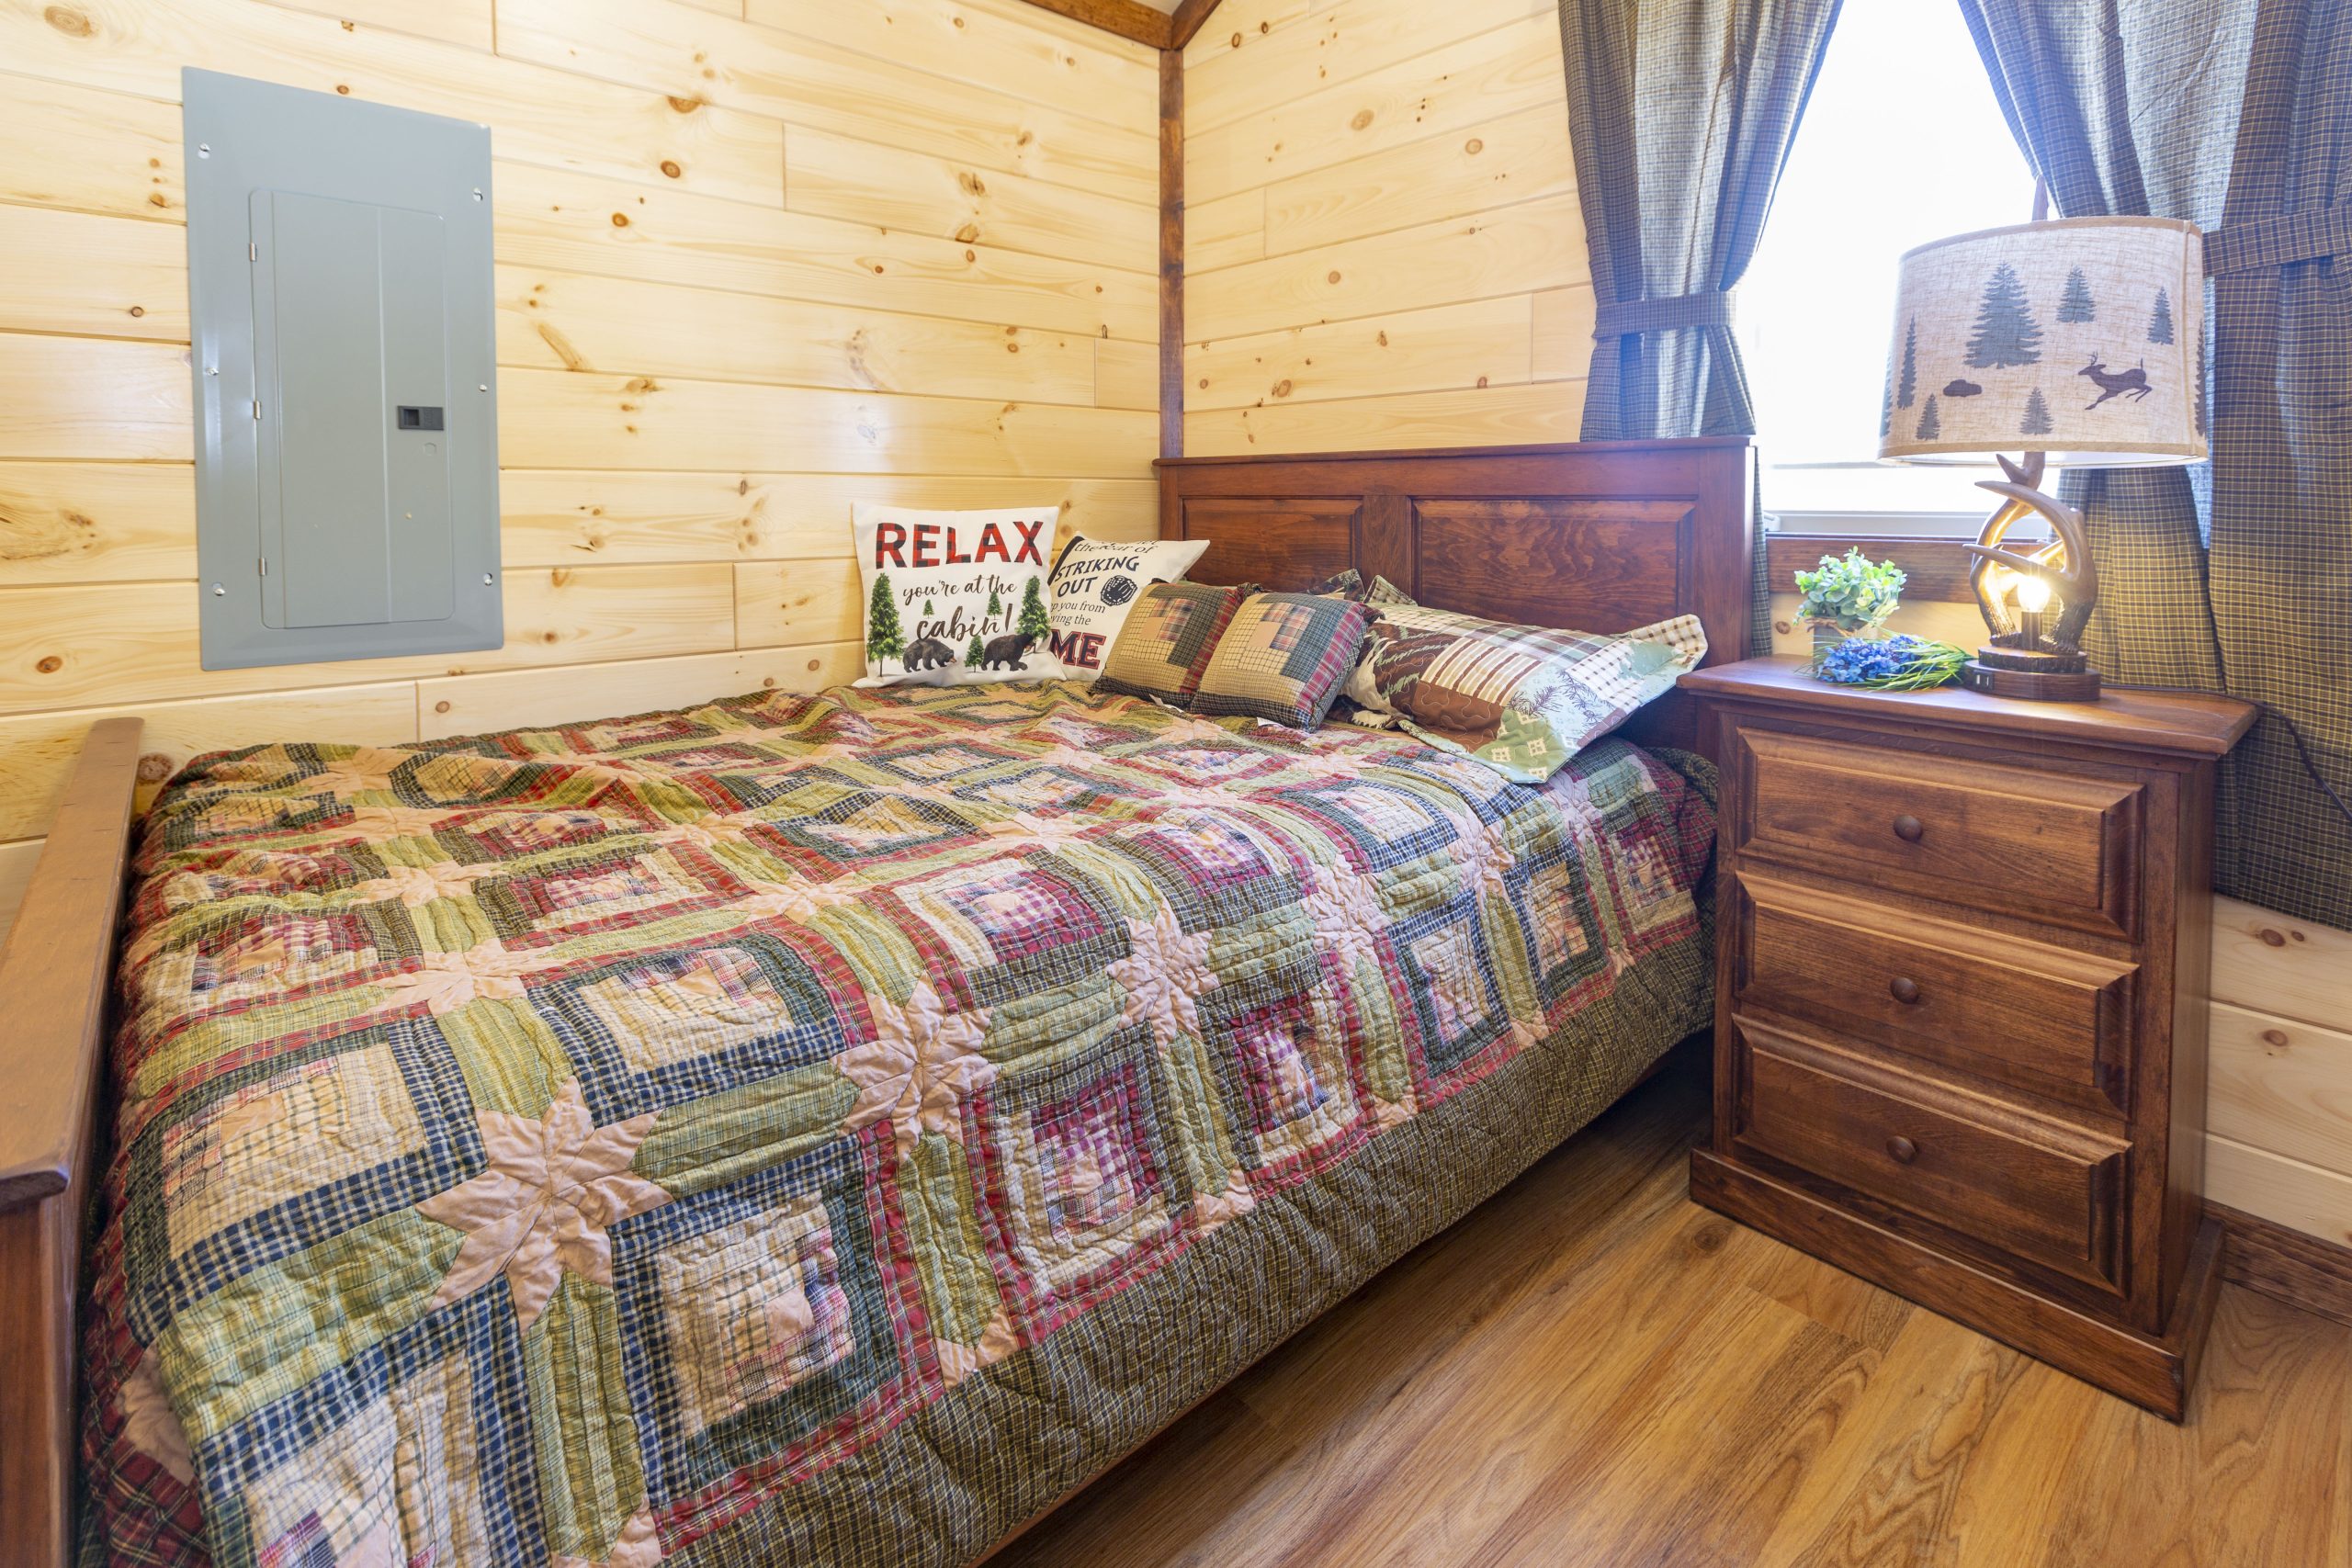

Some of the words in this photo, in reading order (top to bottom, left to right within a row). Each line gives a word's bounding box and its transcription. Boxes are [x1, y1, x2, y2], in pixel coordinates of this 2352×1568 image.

[876, 521, 1044, 570] RELAX
[1135, 545, 1159, 554] of
[1054, 556, 1140, 582] STRIKING
[903, 580, 960, 606] you're
[964, 574, 984, 593] at
[986, 574, 1017, 593] the
[1057, 576, 1099, 598] OUT
[1050, 614, 1072, 626] ying
[1074, 614, 1091, 626] the
[1058, 602, 1078, 613] you
[1079, 600, 1106, 614] from
[916, 603, 1013, 642] cabin!
[1048, 628, 1107, 671] ME
